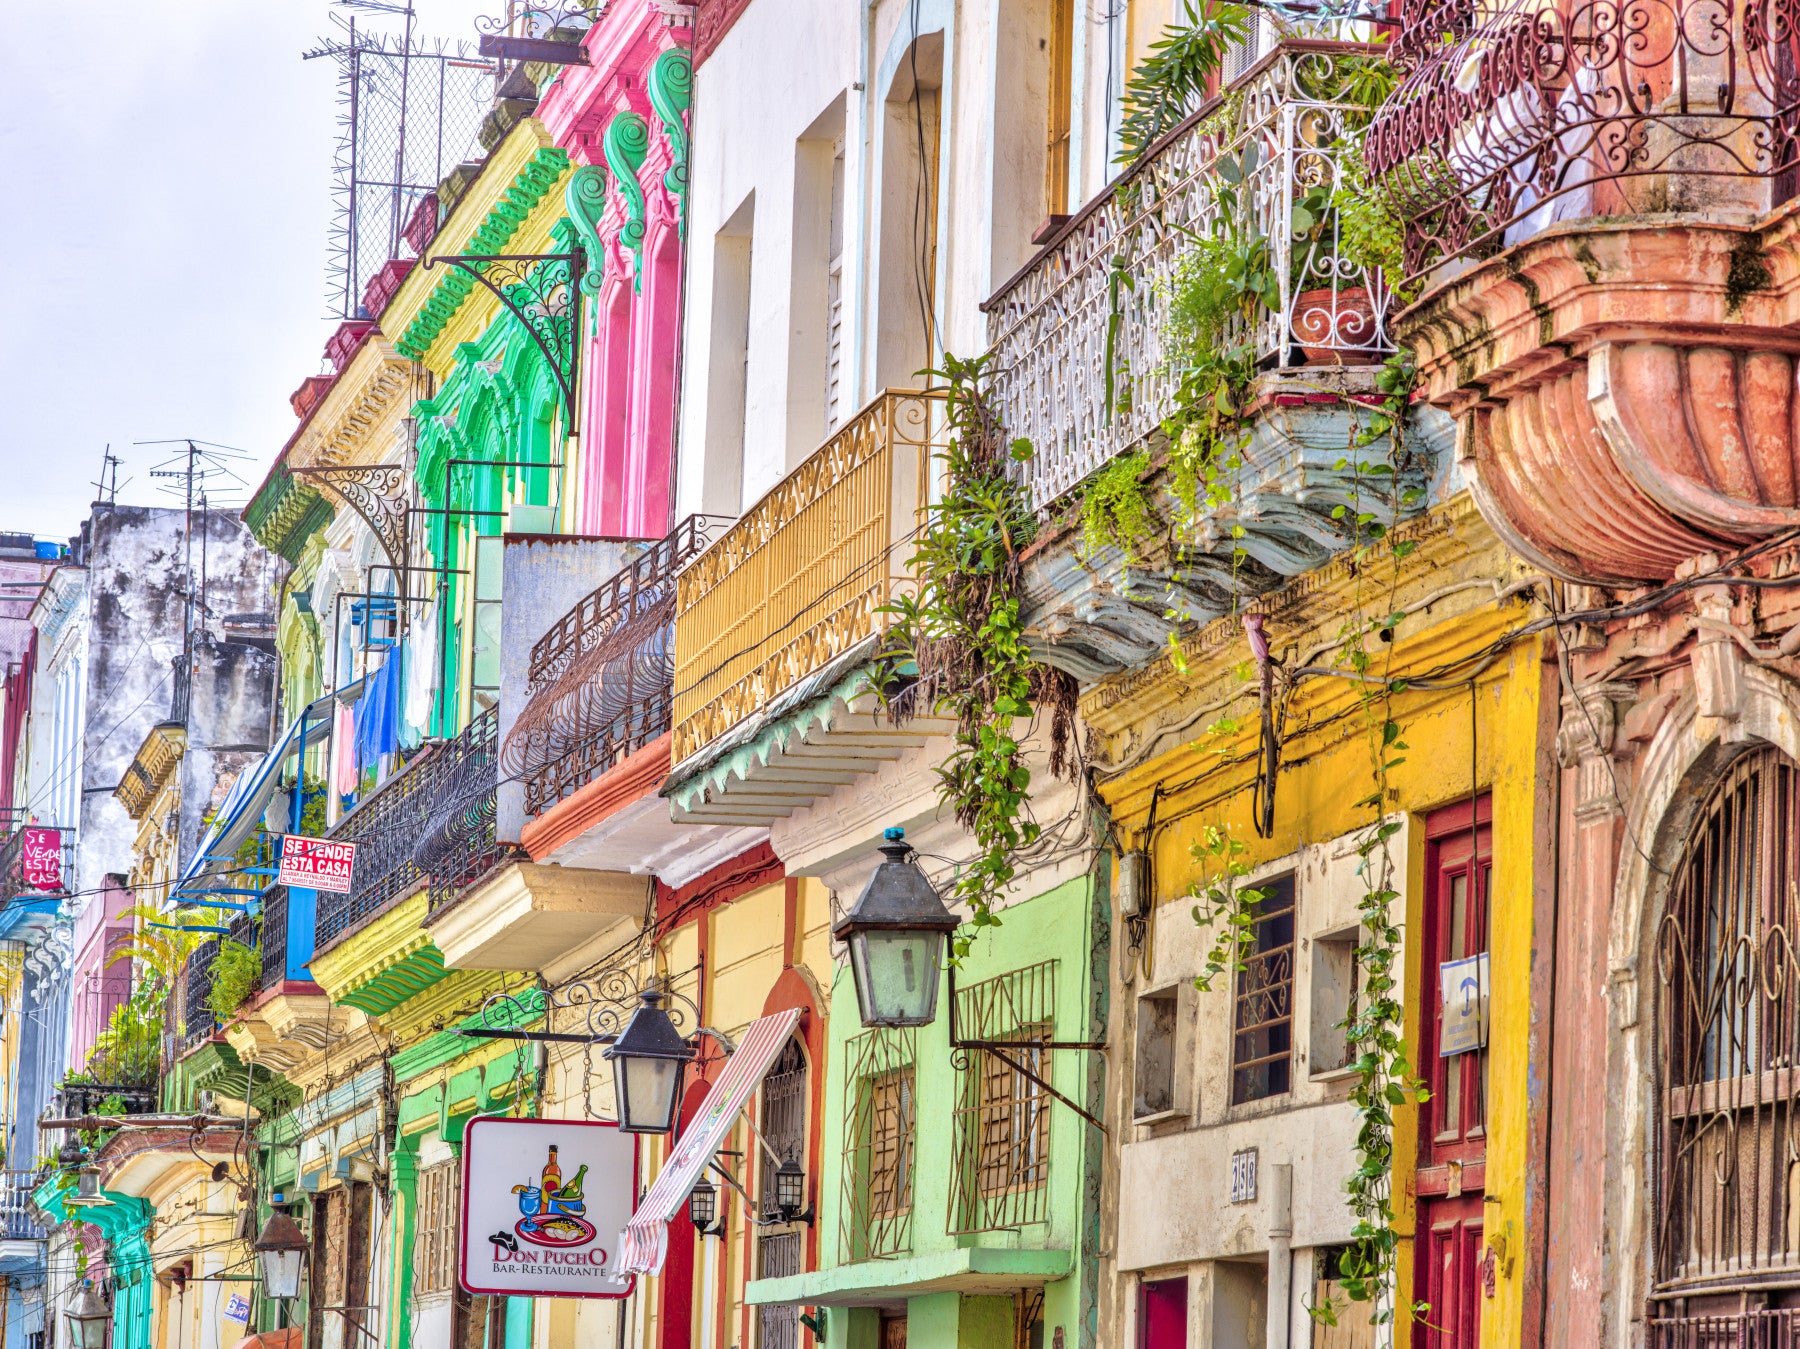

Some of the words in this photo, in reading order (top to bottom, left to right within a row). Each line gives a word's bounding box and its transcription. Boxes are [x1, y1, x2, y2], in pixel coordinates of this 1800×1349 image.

[26, 830, 46, 845] SE
[285, 839, 304, 854] SE
[307, 841, 353, 862] VENDE
[26, 858, 58, 872] ESTA
[283, 856, 314, 873] ESTA
[317, 859, 350, 877] CASA
[1232, 1161, 1255, 1192] 258
[492, 1244, 539, 1263] DON
[543, 1247, 608, 1266] PUCHO
[493, 1262, 607, 1277] BAR-RESTAURANTE
